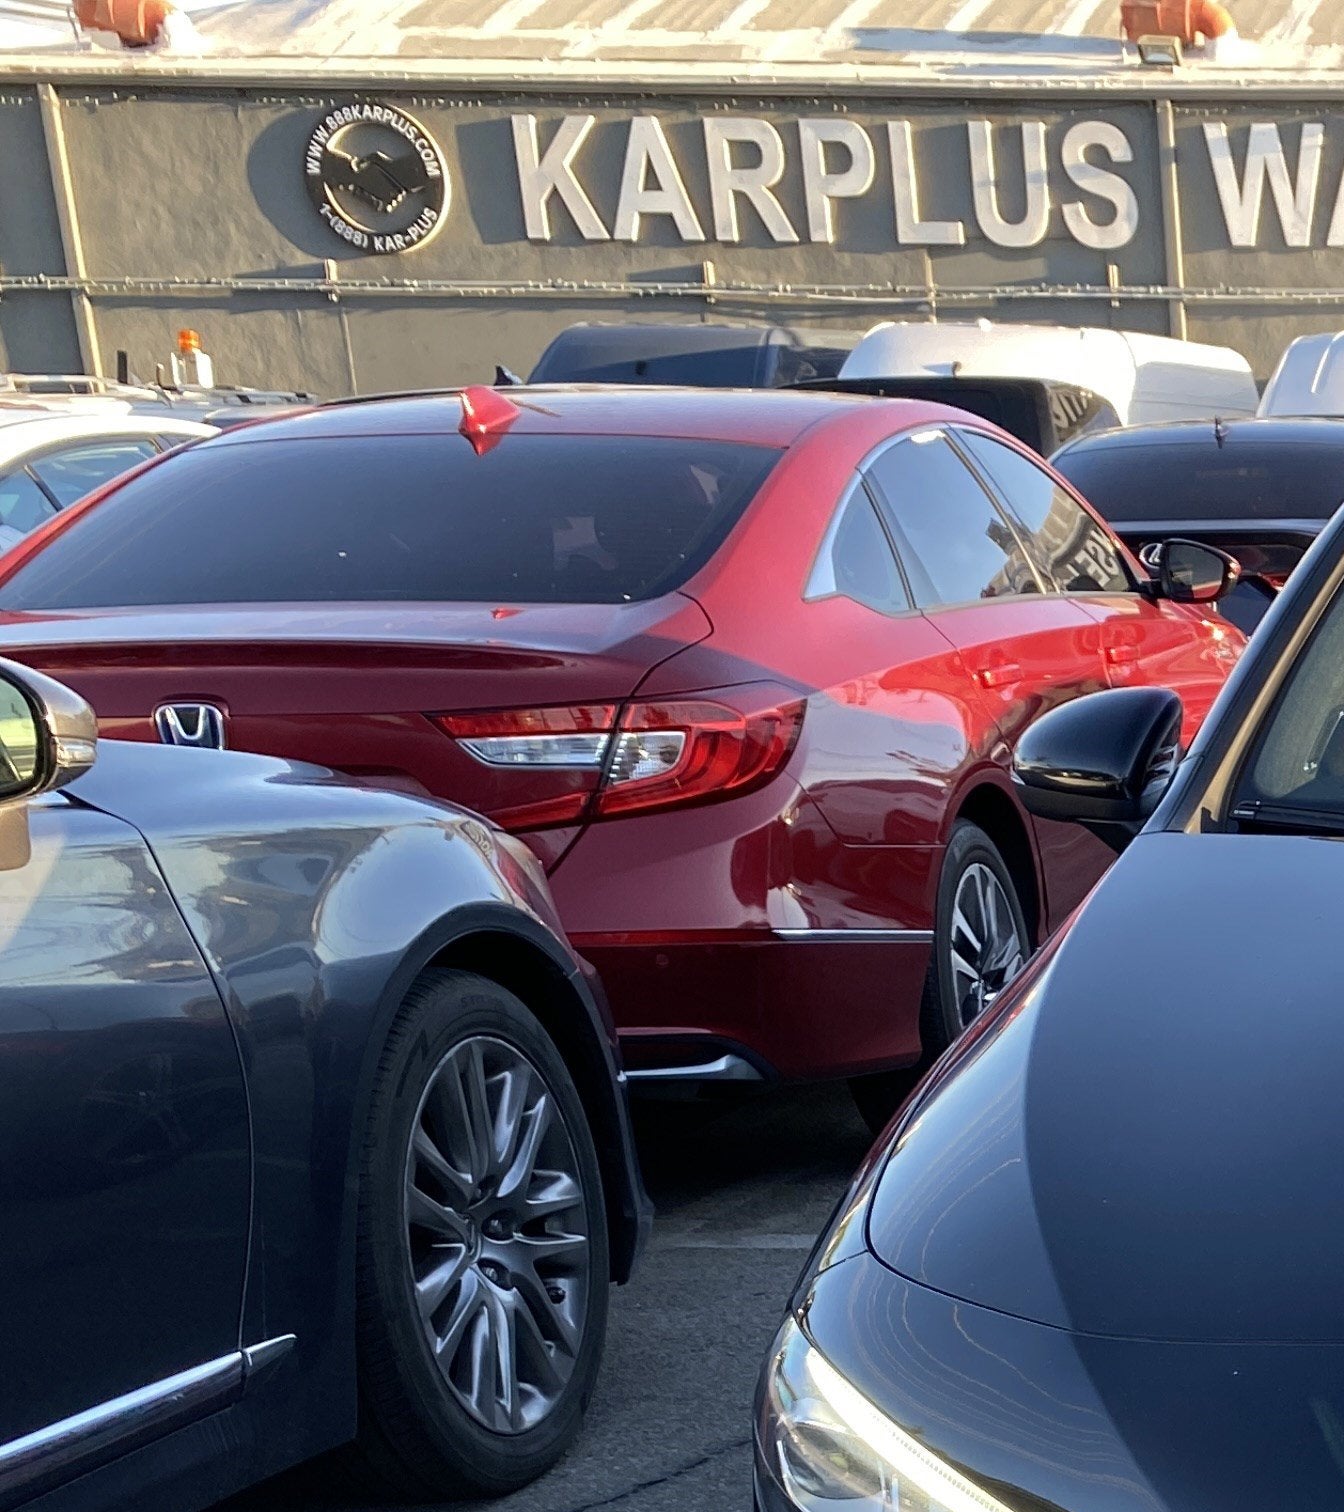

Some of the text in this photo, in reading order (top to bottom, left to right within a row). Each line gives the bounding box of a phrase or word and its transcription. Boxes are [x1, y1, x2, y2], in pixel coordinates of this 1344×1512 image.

[305, 104, 441, 178] WWW.888KARPLUS.COM
[510, 114, 1140, 250] KARPLUS
[319, 203, 438, 251] 1-(888) KAR-PLUS
